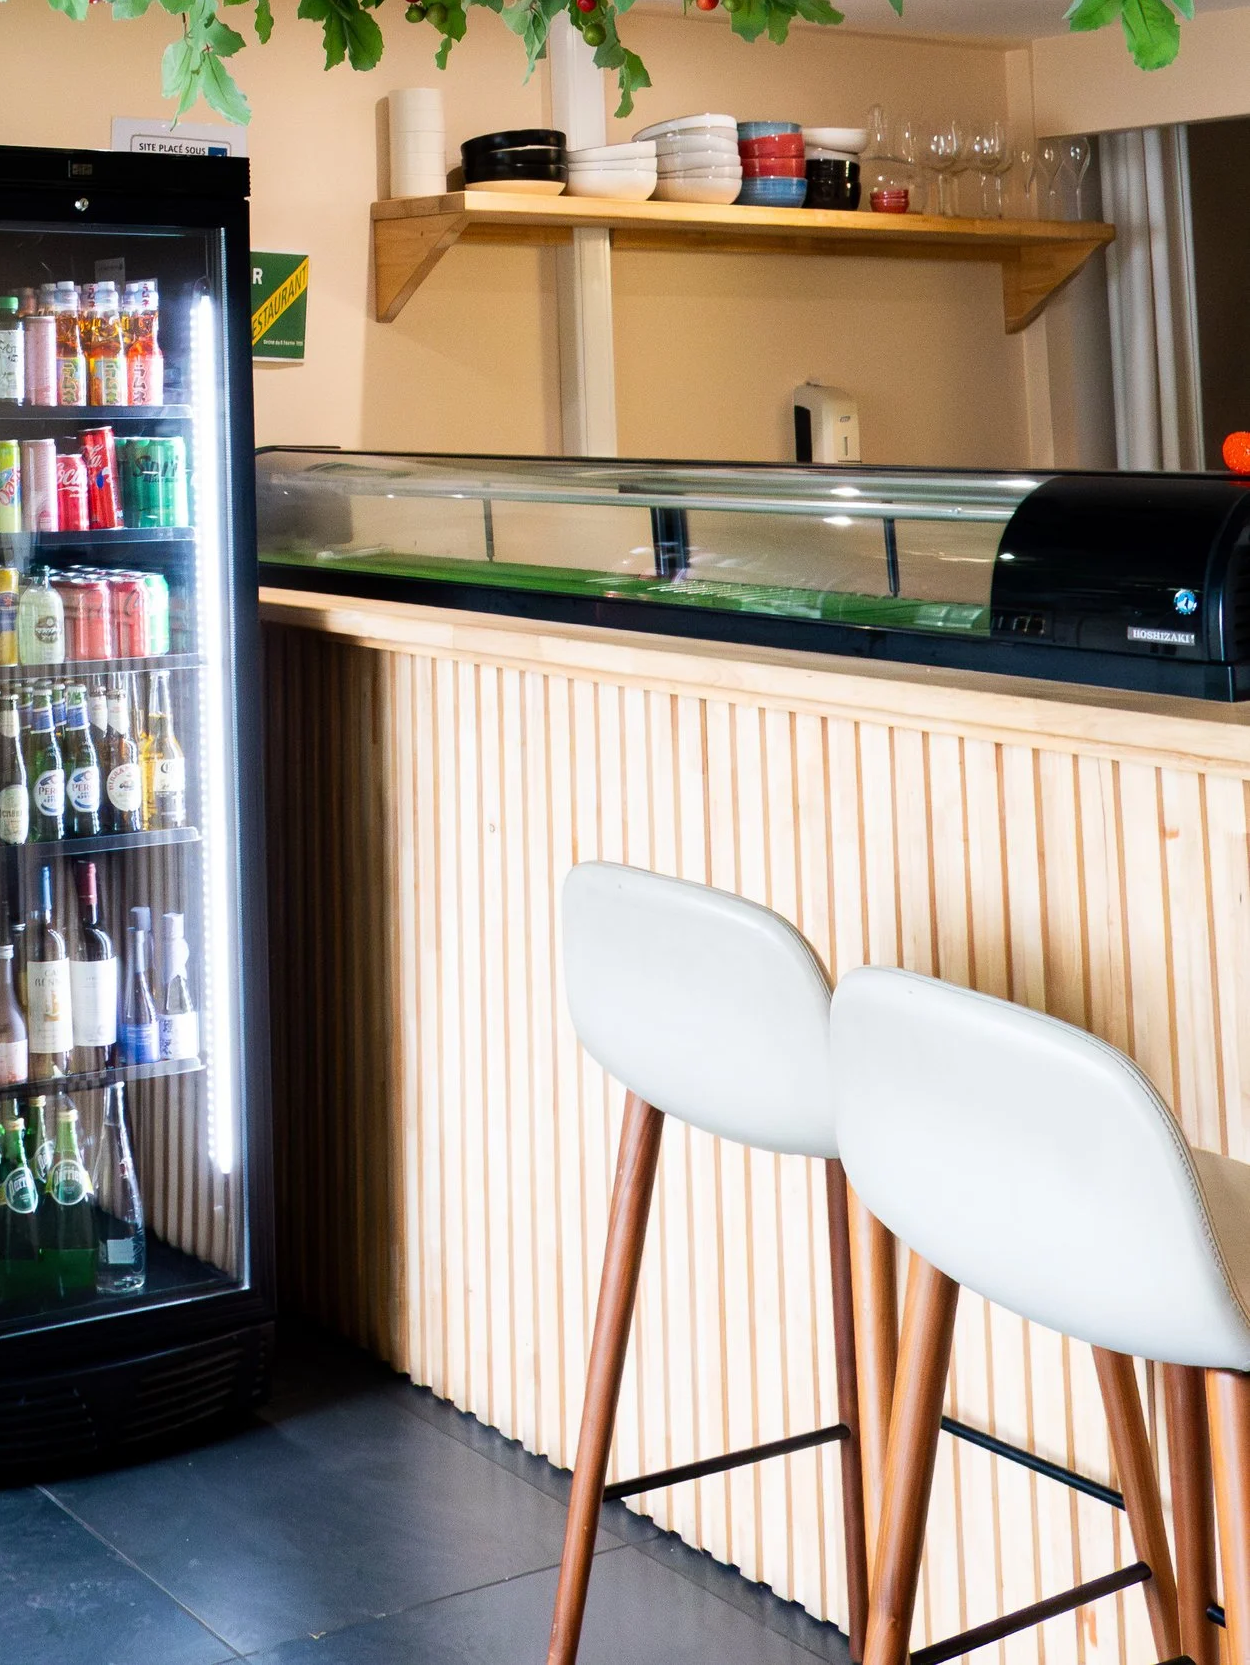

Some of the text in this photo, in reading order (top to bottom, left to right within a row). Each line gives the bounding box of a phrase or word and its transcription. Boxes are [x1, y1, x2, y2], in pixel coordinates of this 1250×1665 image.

[139, 142, 206, 155] SITE PLACÉ SOUS
[252, 264, 307, 339] ESTAURANT
[1132, 629, 1191, 644] HOSHIZAKI
